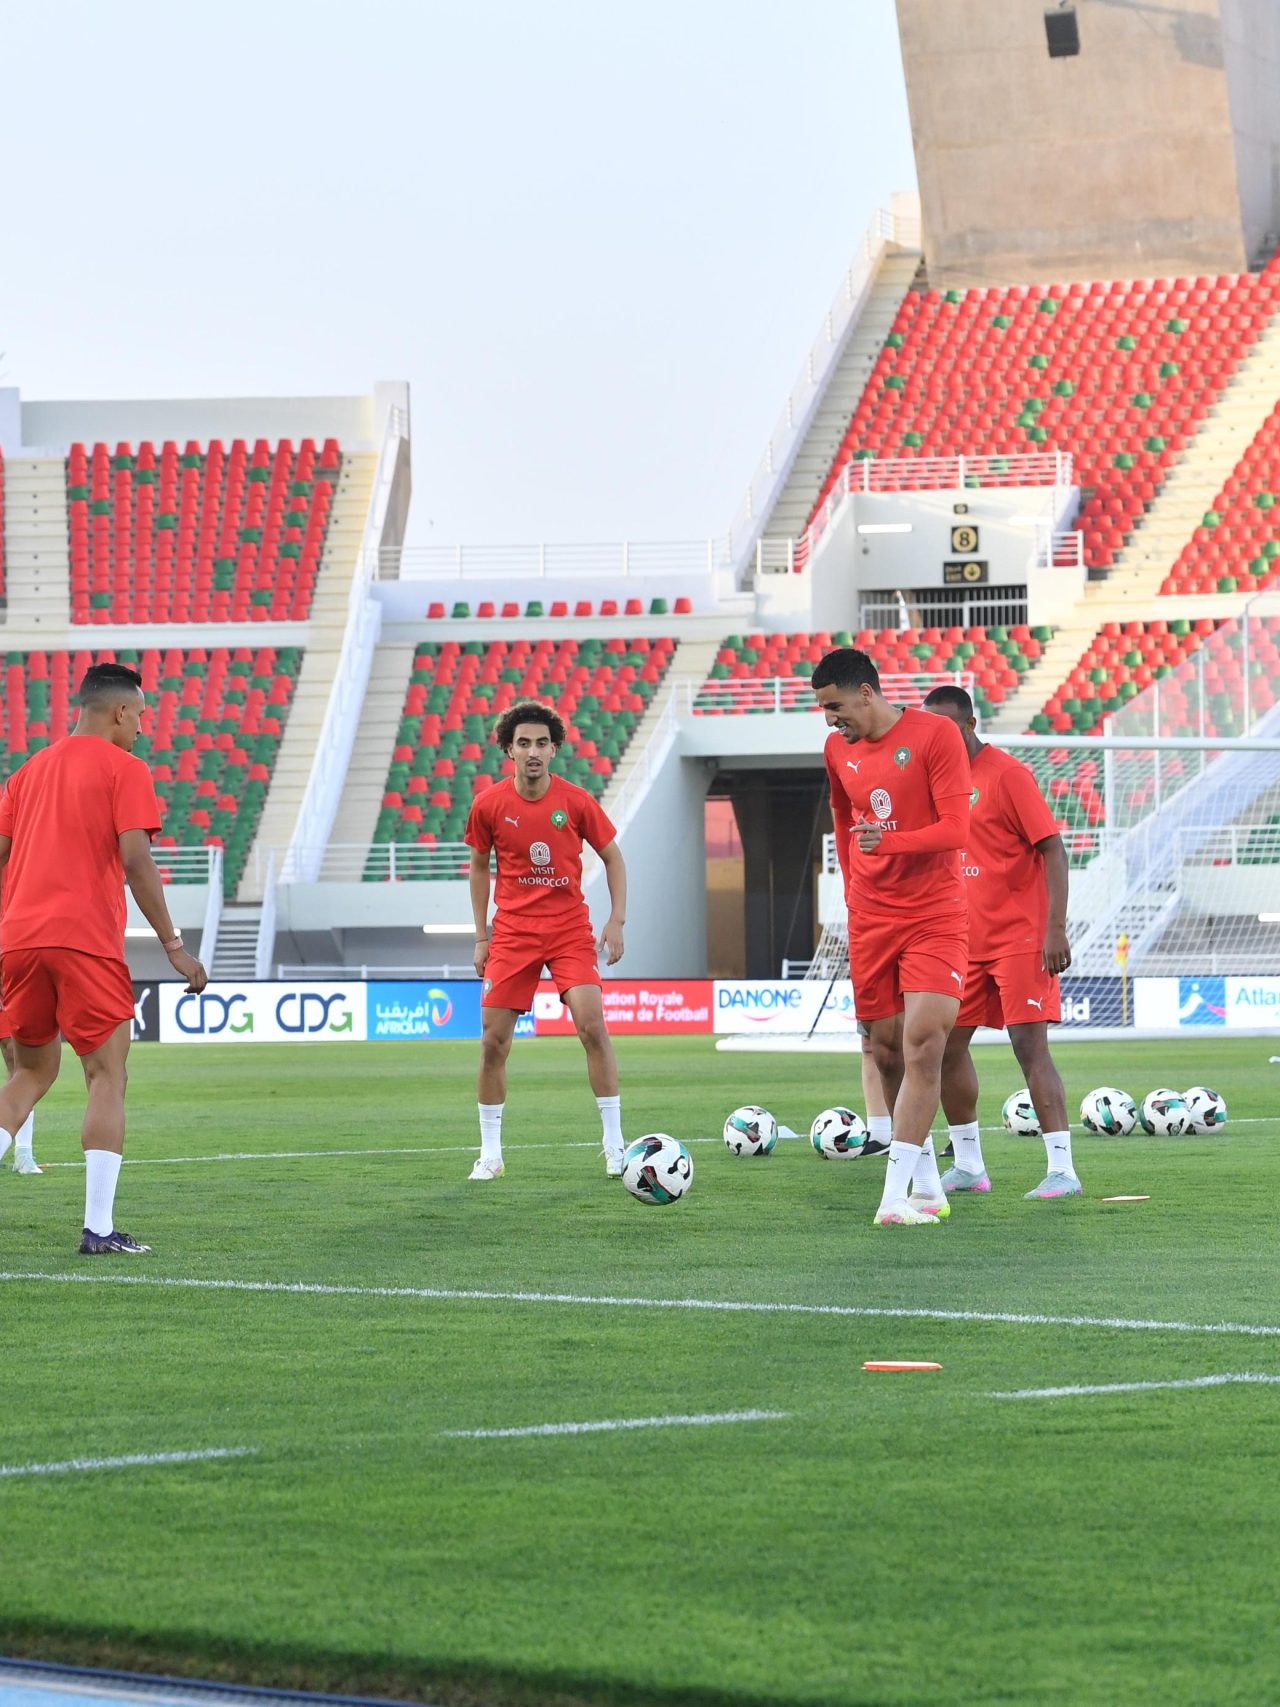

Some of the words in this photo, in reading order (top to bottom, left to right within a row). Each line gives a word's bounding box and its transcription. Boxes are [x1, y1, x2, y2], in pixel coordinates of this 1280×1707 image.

[959, 531, 970, 547] 8
[531, 867, 555, 875] VISIT
[518, 876, 569, 888] MOROCCO
[639, 990, 684, 1010] Royale
[175, 993, 255, 1034] CDG
[275, 993, 353, 1033] CDG
[637, 1007, 654, 1022] de
[656, 1006, 709, 1022] Football
[375, 1020, 431, 1035] AFRIQUIA
